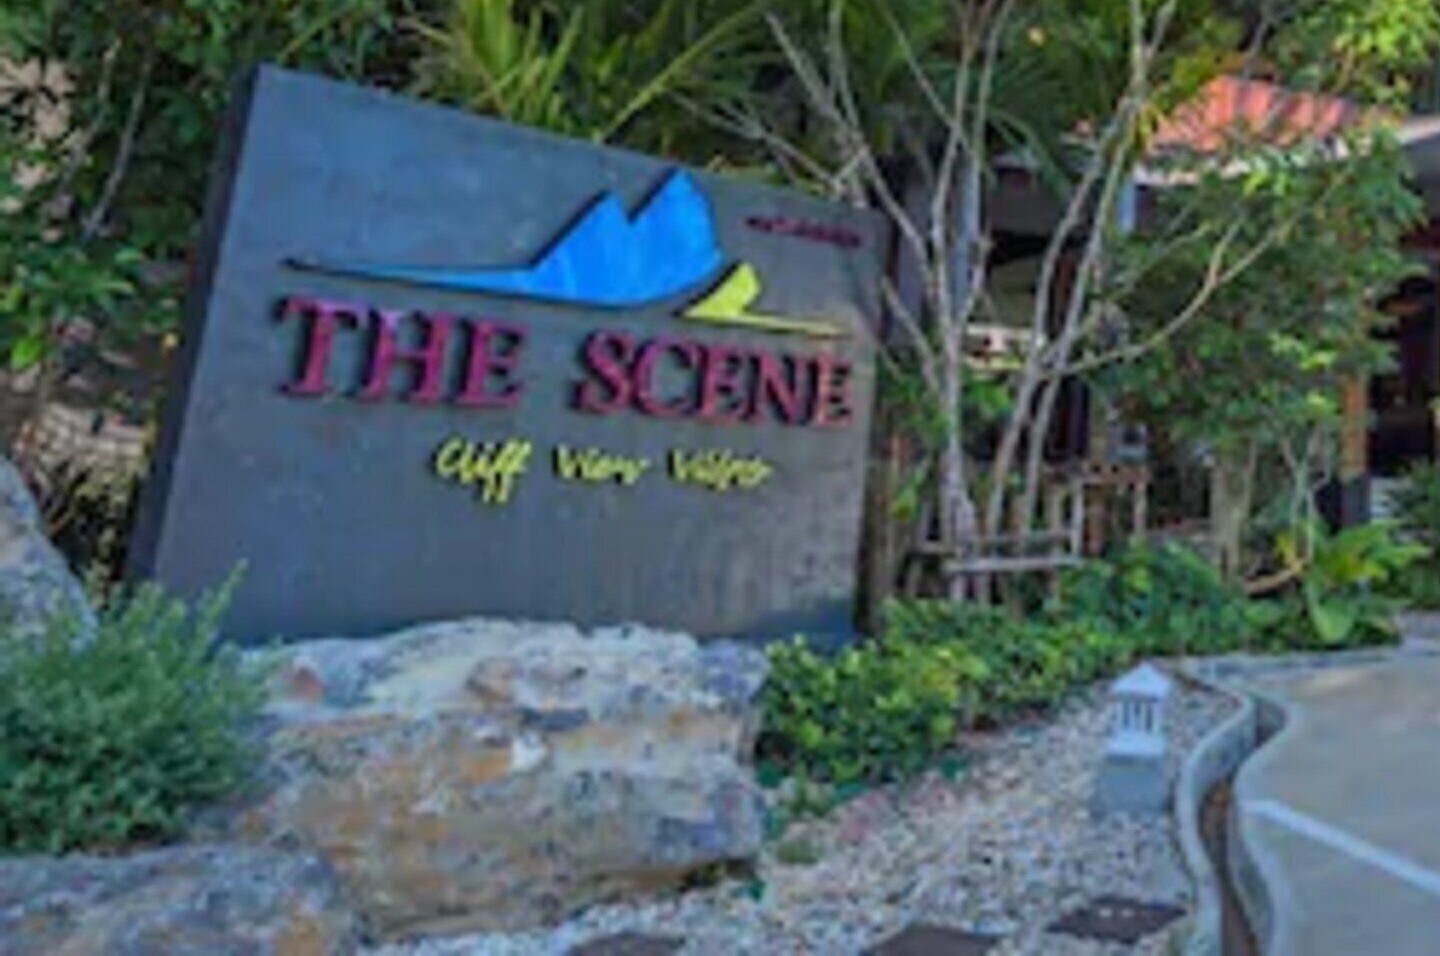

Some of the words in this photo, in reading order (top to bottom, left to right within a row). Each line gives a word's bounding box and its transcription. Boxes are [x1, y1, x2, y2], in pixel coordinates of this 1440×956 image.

[279, 291, 530, 406] THE
[573, 328, 851, 426] SCENE
[434, 438, 532, 504] Cliff
